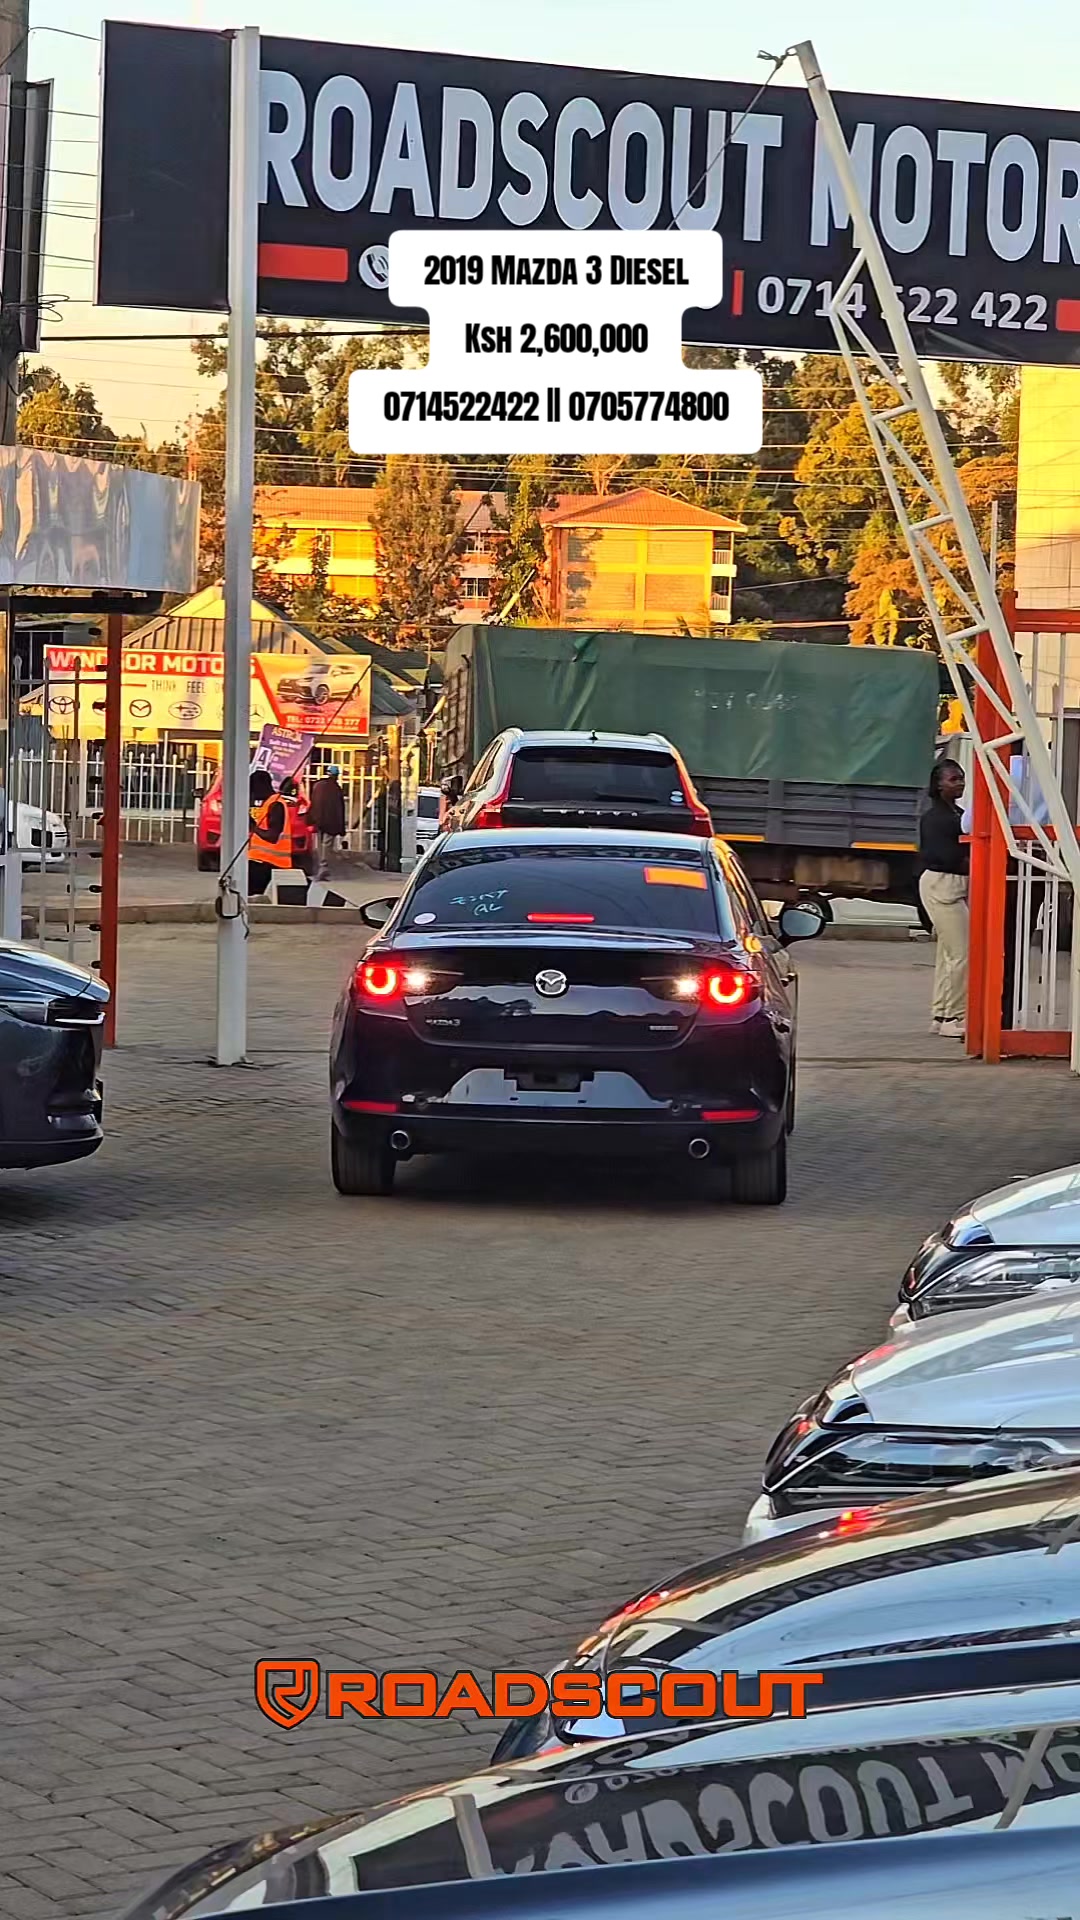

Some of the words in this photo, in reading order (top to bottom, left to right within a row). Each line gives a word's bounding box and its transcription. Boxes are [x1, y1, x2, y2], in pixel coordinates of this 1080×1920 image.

[259, 69, 783, 242] ROADSCOUT
[757, 276, 867, 318] 0714
[970, 291, 1048, 332] 422
[186, 680, 206, 694] FEEL
